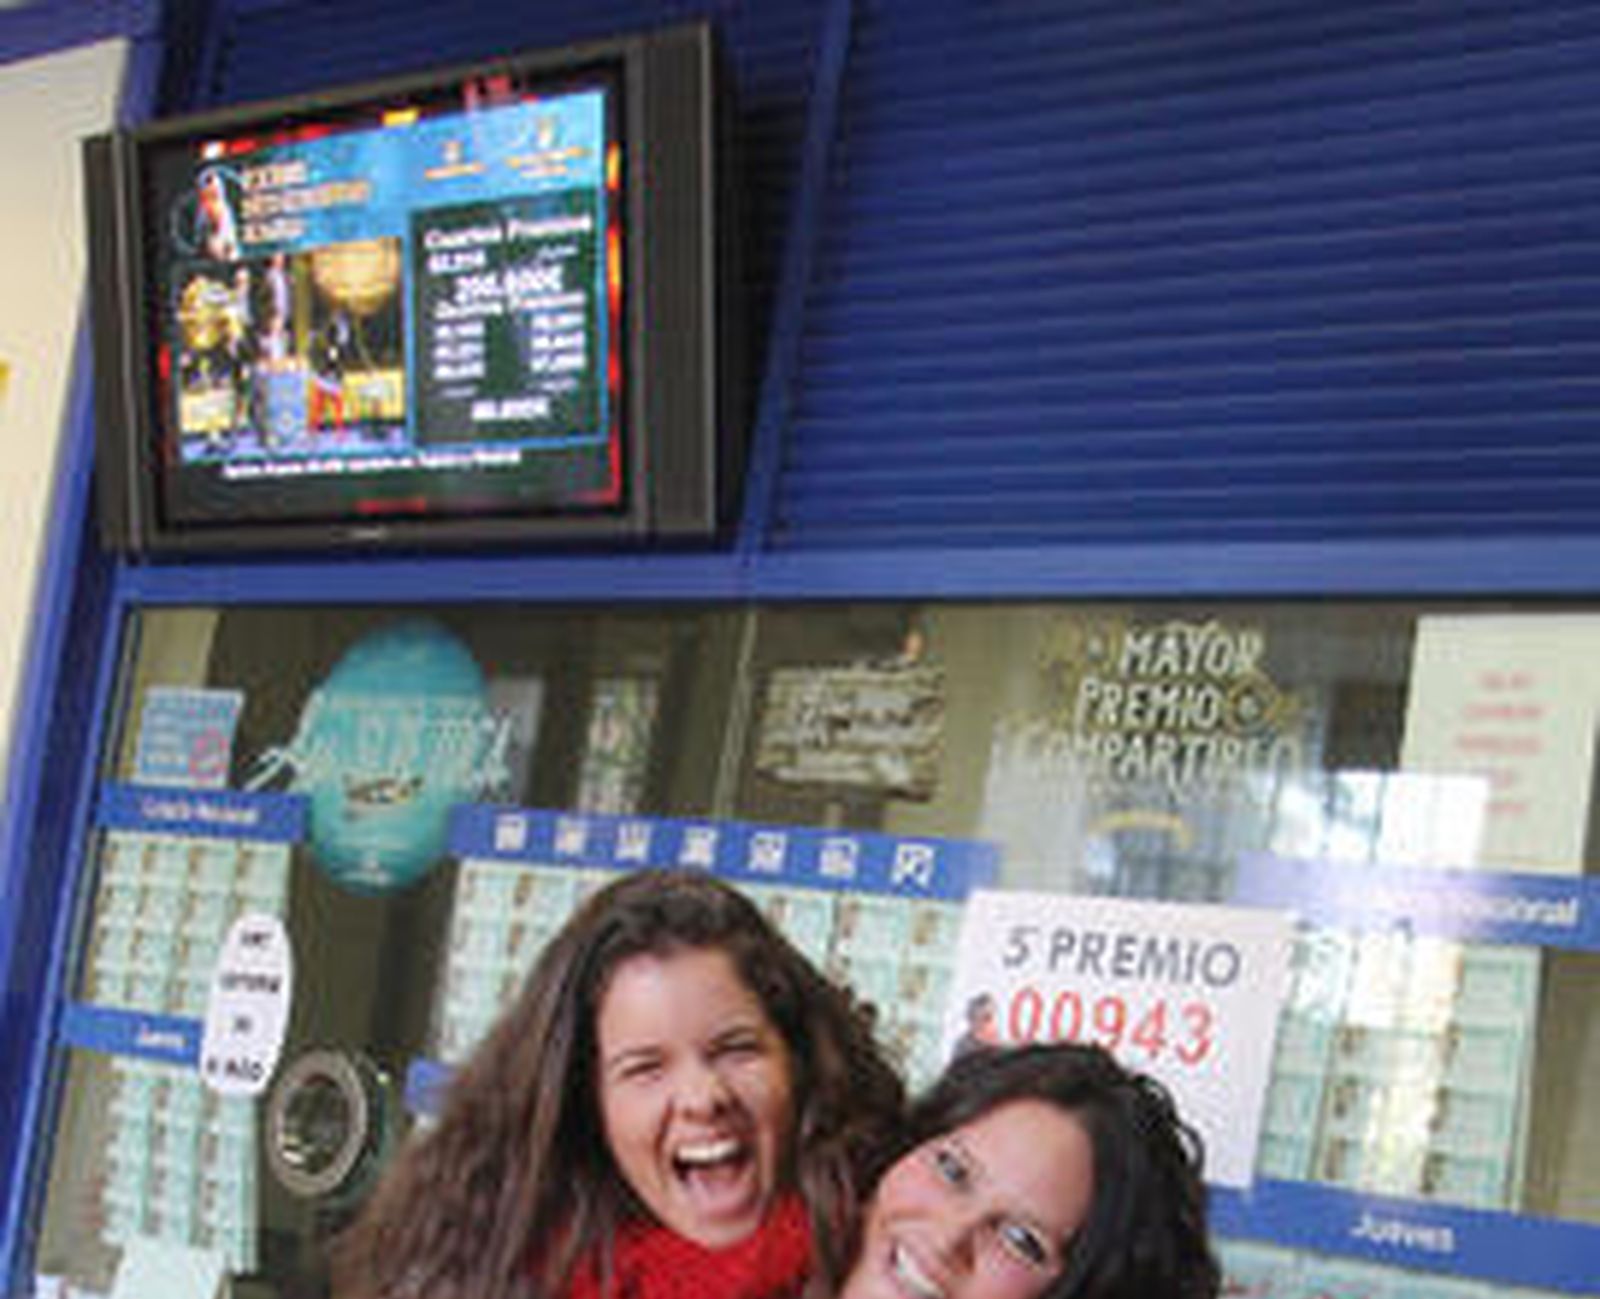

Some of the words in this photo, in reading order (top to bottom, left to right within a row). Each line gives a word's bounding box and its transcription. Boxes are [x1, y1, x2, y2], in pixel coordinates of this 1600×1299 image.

[1118, 622, 1267, 676] MAYOR
[1074, 675, 1222, 743] PREMIO
[1049, 927, 1242, 988] PREMIO
[1008, 986, 1214, 1066] 00943
